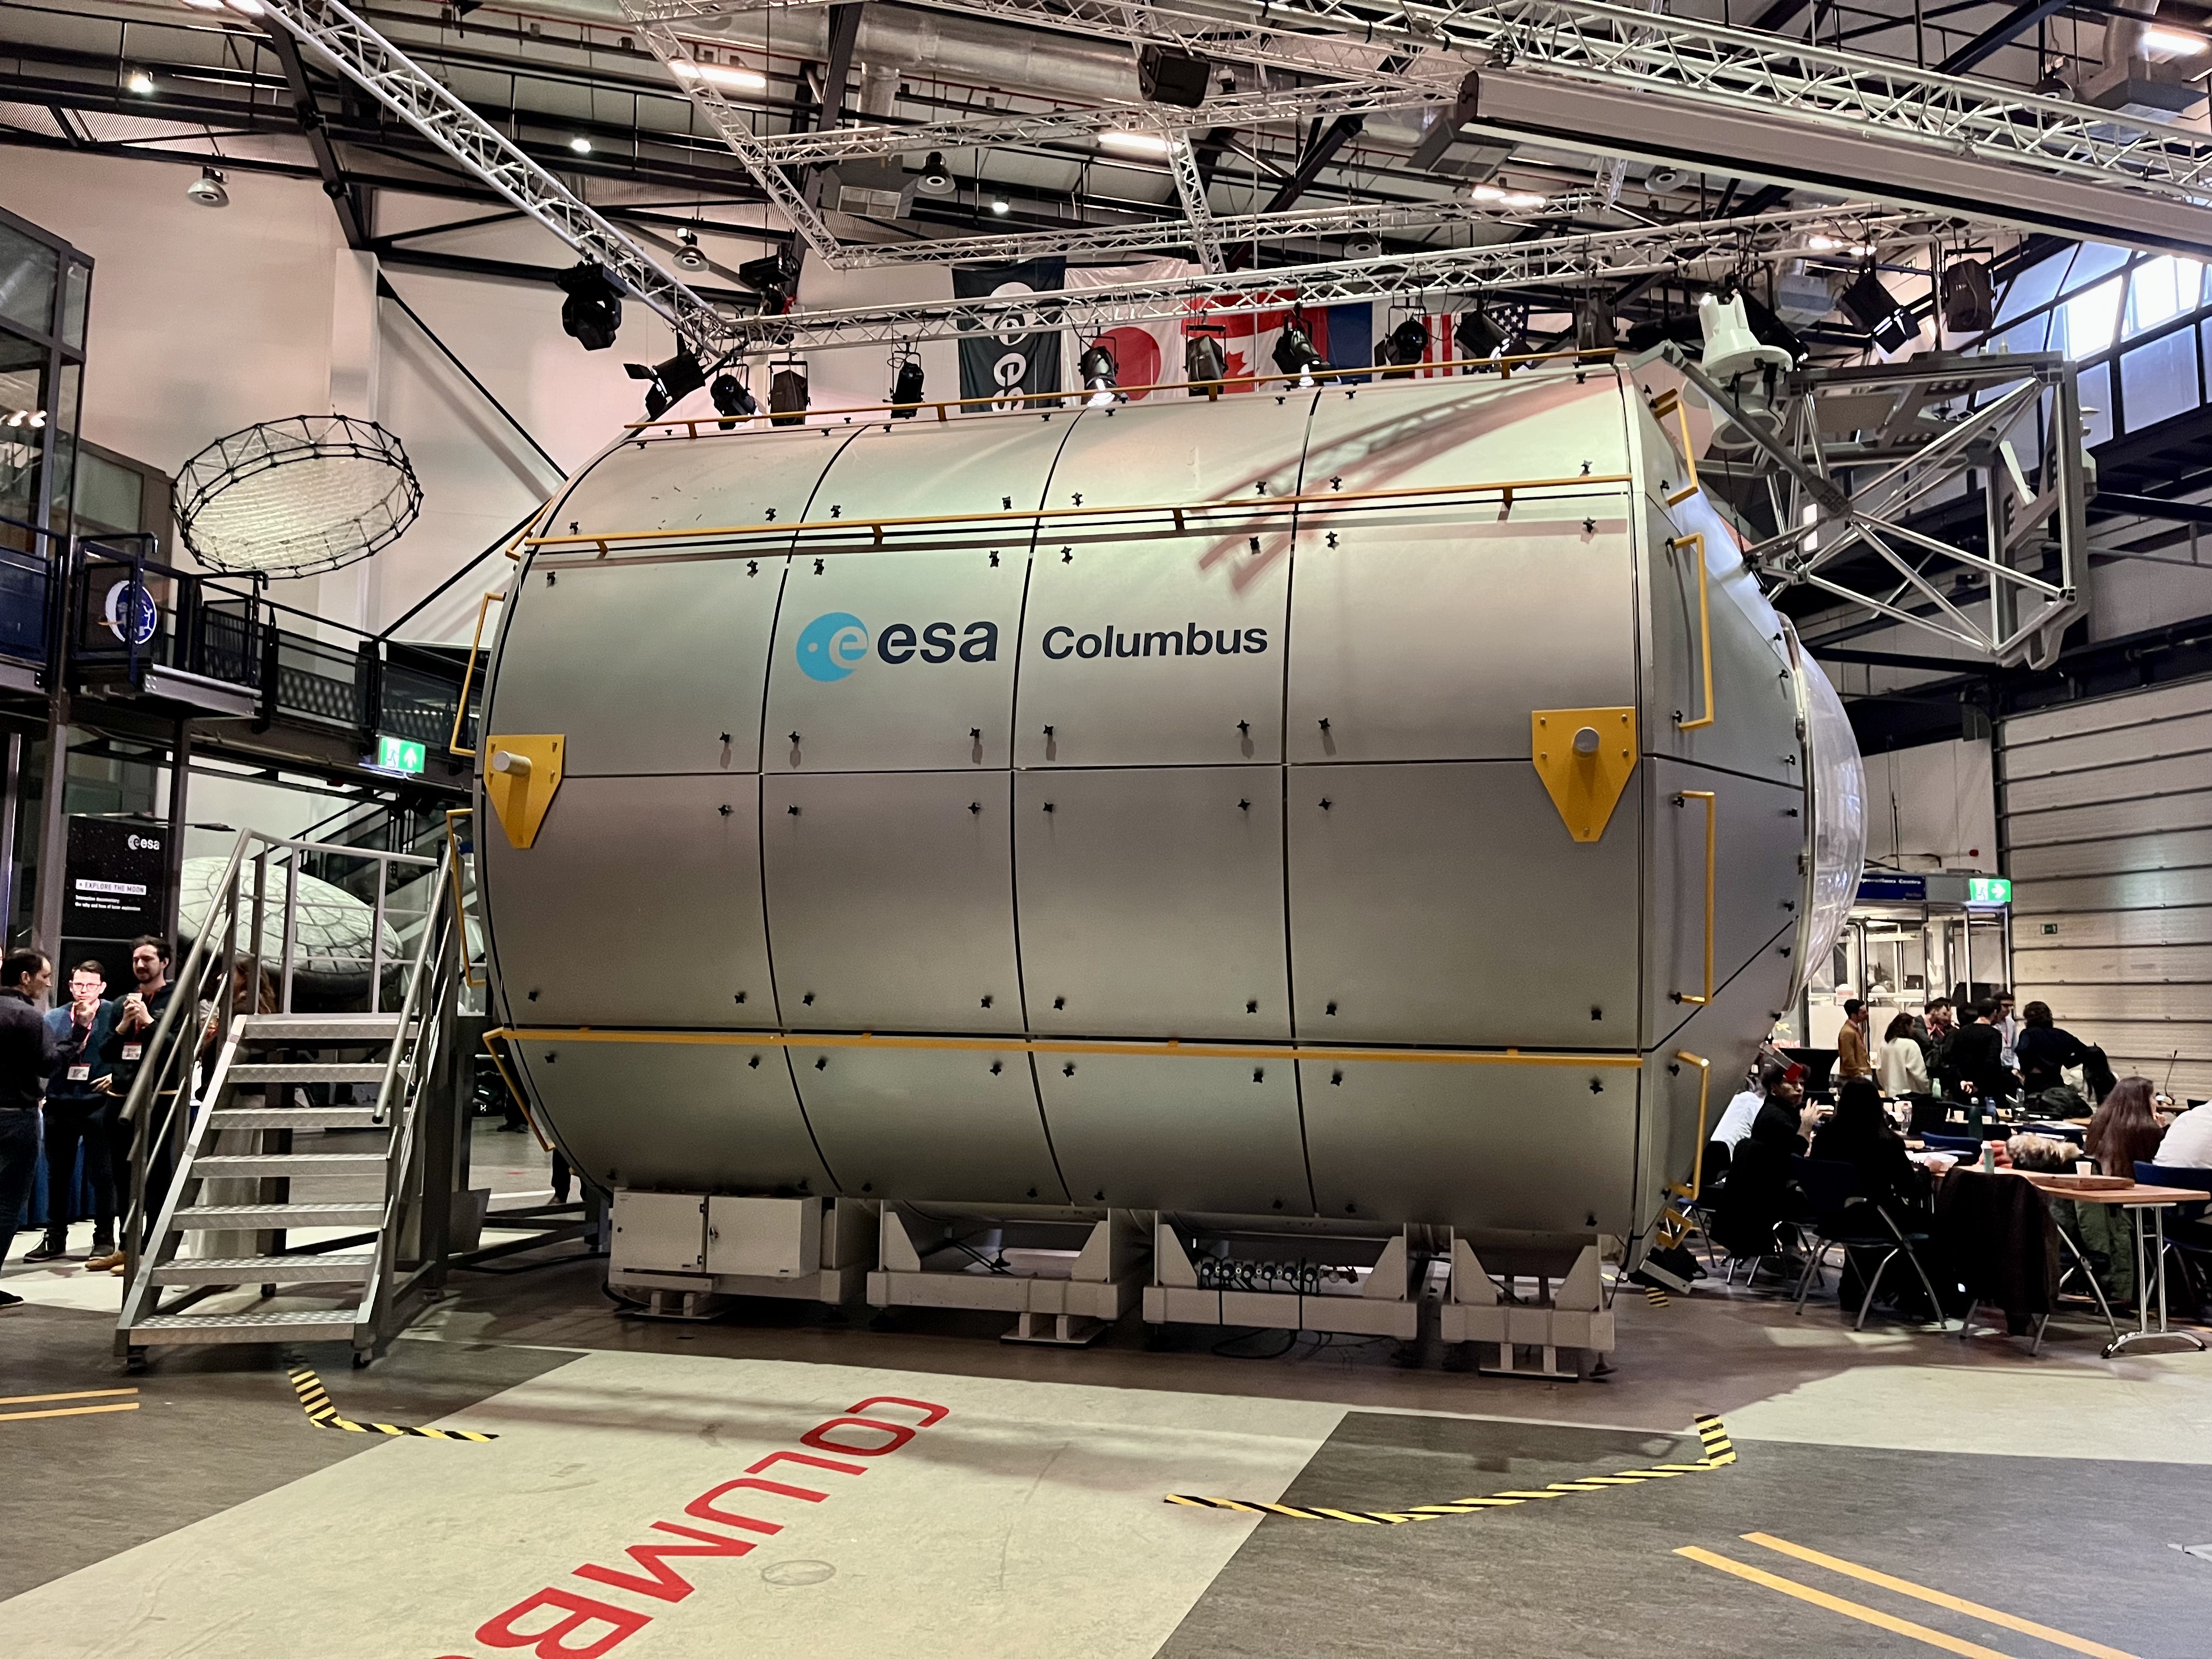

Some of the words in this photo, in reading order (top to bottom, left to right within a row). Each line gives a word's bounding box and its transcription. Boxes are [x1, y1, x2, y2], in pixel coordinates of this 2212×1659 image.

[878, 620, 999, 664] esa
[1042, 623, 1268, 659] Columbus
[140, 839, 160, 850] esa
[85, 882, 111, 891] EXPLORE
[433, 1396, 950, 1659] COLUMB
